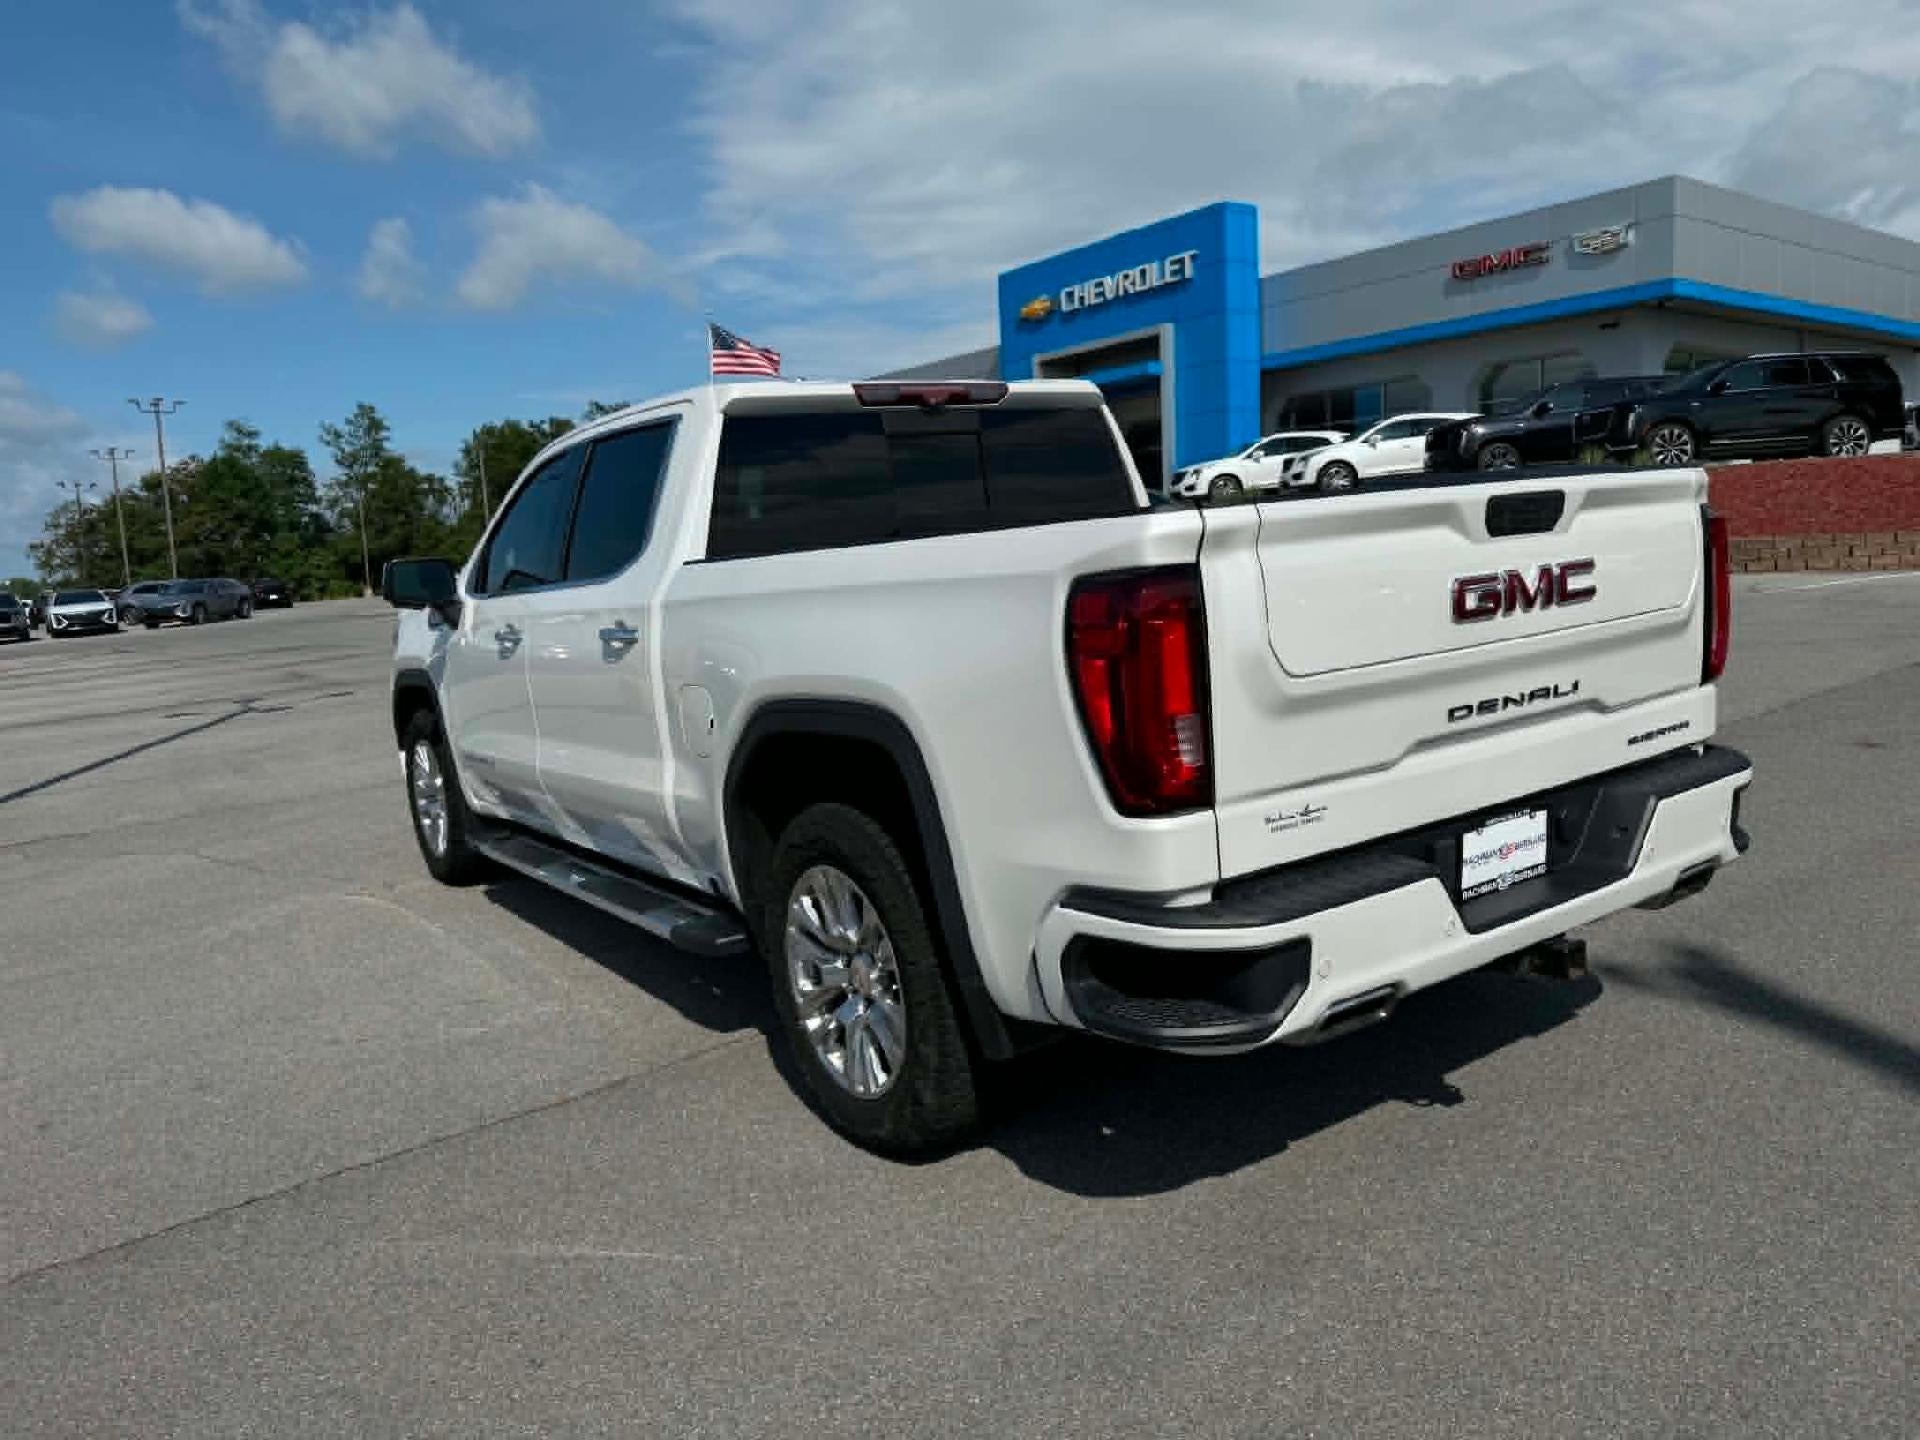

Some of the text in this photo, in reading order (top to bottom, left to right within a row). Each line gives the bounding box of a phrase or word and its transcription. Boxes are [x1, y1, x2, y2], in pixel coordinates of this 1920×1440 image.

[1059, 250, 1199, 313] CHEVROLET
[1452, 242, 1549, 279] GMC
[1452, 557, 1597, 624] GMC
[1448, 680, 1580, 723] DENALI
